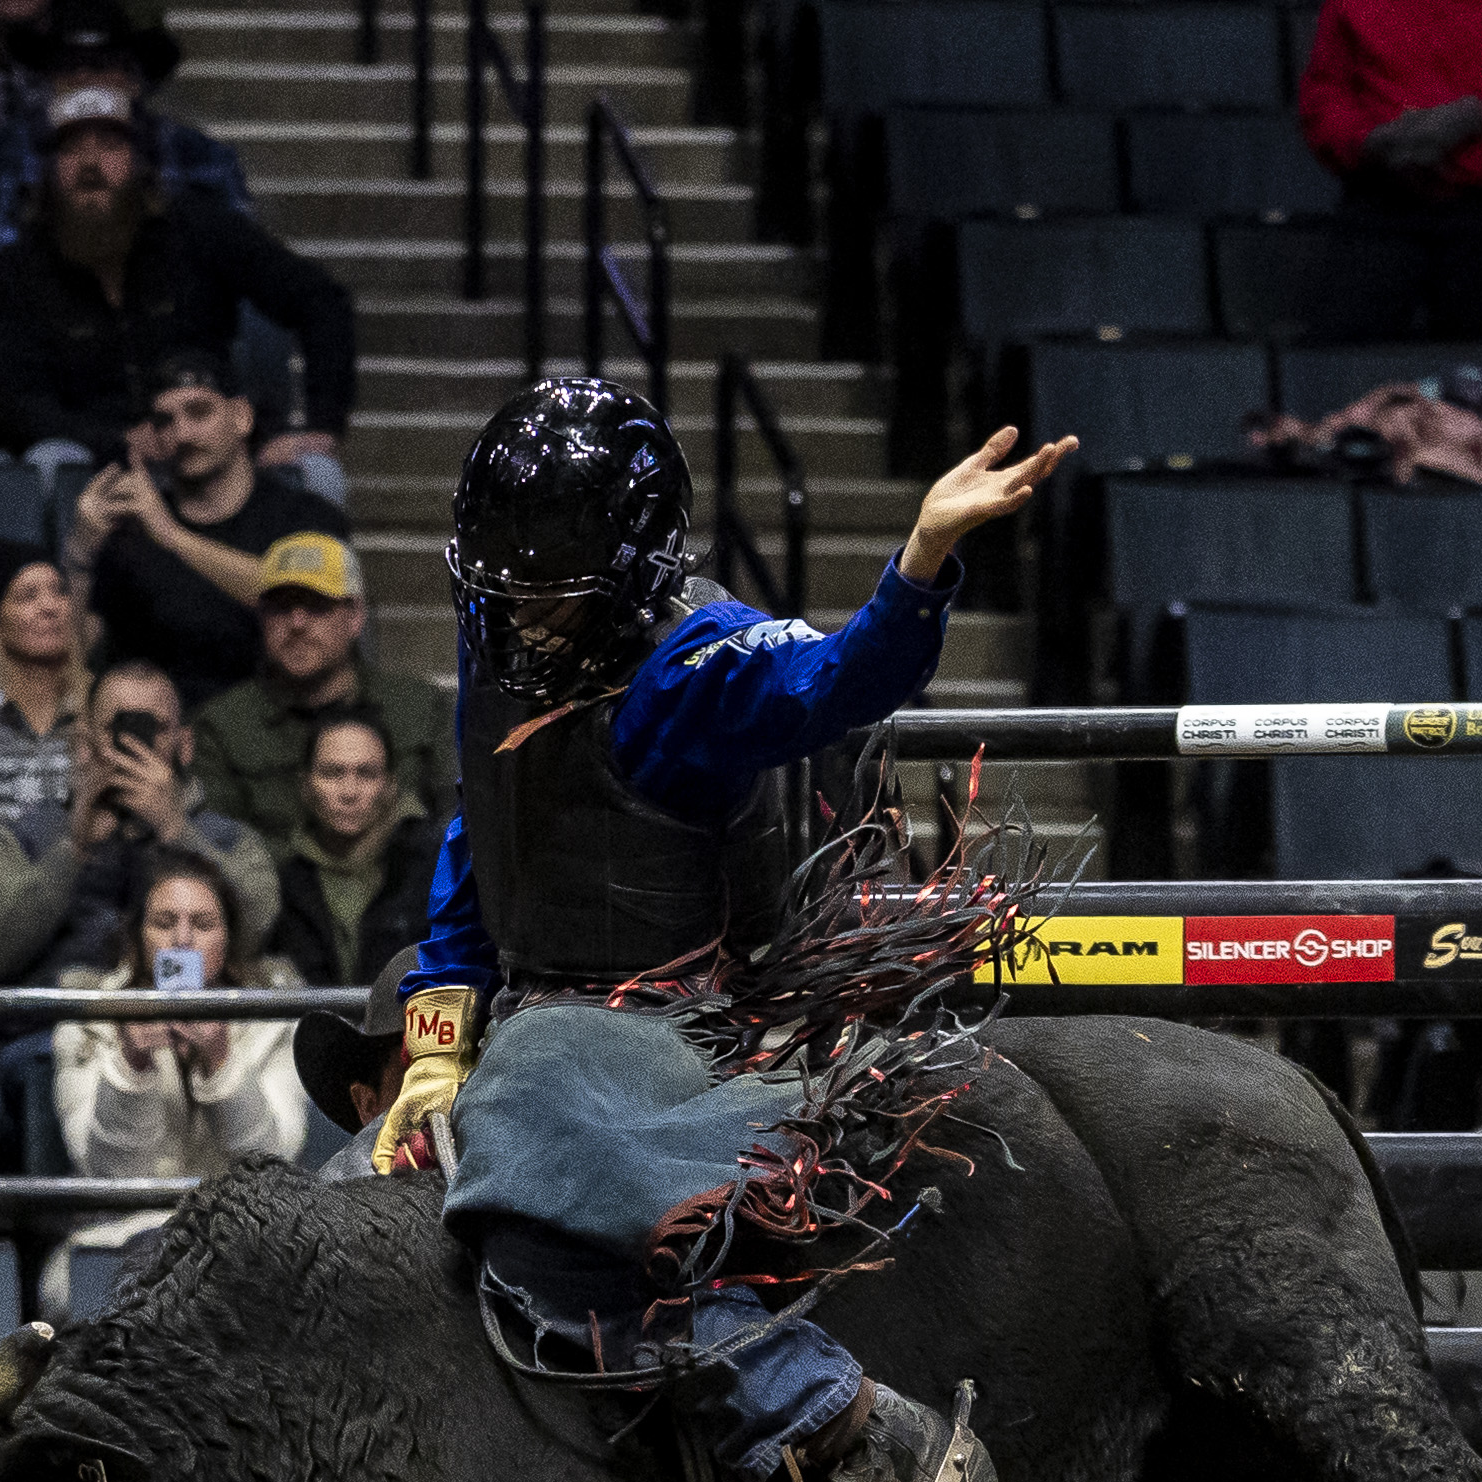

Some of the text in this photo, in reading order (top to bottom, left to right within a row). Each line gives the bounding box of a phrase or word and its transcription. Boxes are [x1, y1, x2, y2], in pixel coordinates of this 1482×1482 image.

[1183, 718, 1237, 727] CORPUS
[1254, 717, 1308, 726] CORPUS
[1325, 717, 1380, 726] CORPUS
[1182, 729, 1237, 740] CHRISTI
[1253, 728, 1308, 739] CHRISTI
[1324, 728, 1380, 739] CHRISTI
[1049, 941, 1159, 956] RAM
[1187, 939, 1393, 960] SILENCER SHOP
